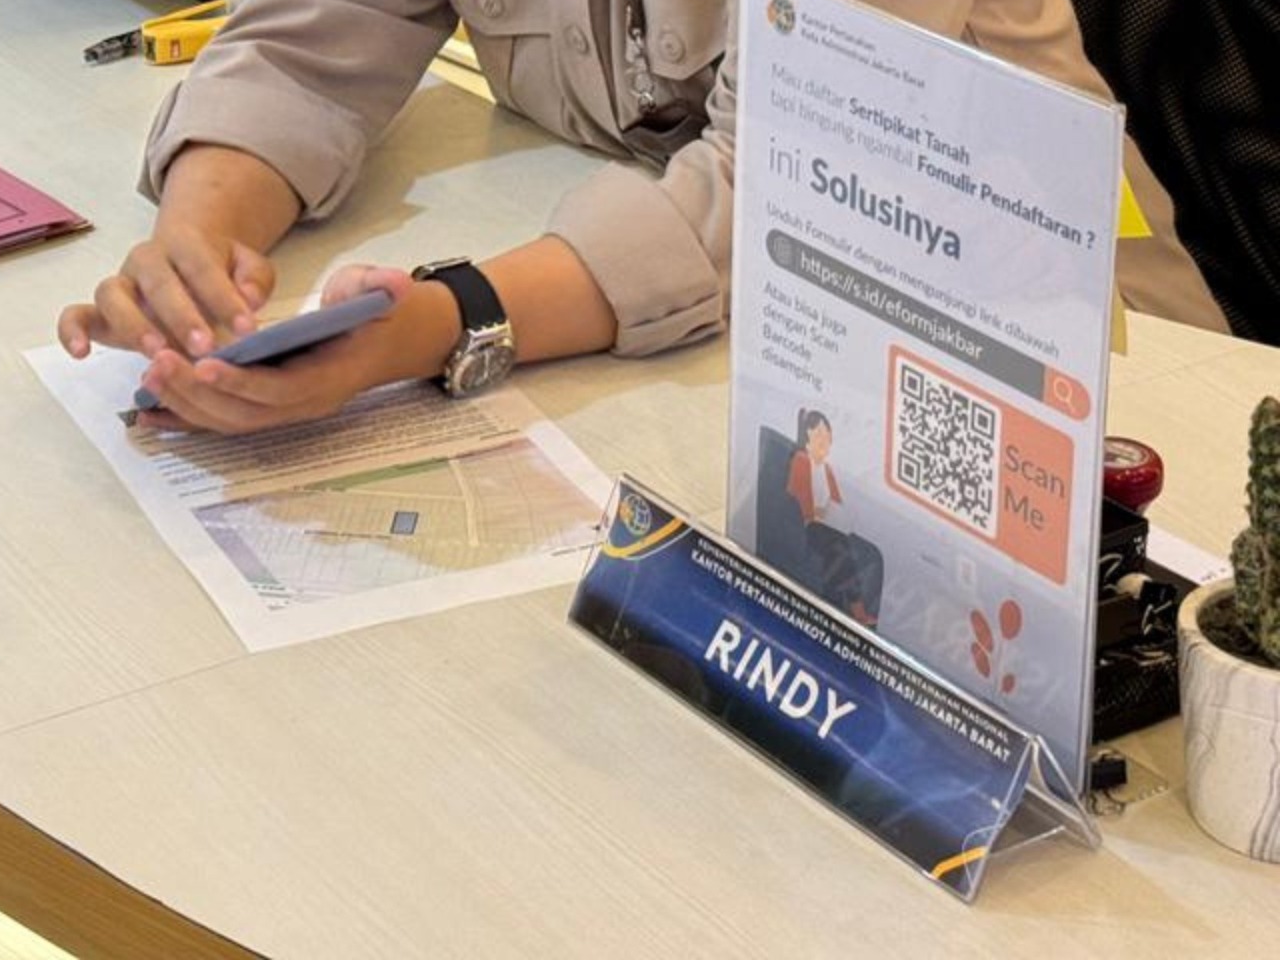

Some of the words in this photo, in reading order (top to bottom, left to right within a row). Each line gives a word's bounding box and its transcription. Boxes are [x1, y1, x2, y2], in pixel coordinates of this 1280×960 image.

[771, 63, 802, 91] Mau
[805, 79, 847, 110] daftar
[848, 96, 922, 146] Sertipikat
[924, 128, 971, 167] Tanah
[902, 71, 926, 89] Barat
[769, 136, 803, 183] ini
[809, 156, 962, 261] Solusinya
[917, 154, 978, 198] Fomulir
[980, 182, 1084, 246] Pendaftaran
[1086, 230, 1097, 250] ?
[763, 280, 793, 308] Atau
[767, 200, 804, 232] Unduh
[853, 246, 898, 279] dengan
[979, 306, 1003, 329] link
[1004, 320, 1062, 361] dibawah
[800, 249, 986, 362] https://s.id/eformjakbar
[1003, 484, 1046, 532] Me
[1004, 443, 1066, 500] Scan
[690, 549, 734, 586] KANTOR
[832, 640, 915, 703] ADMINISTRASI
[913, 694, 968, 738] JAKARTA
[968, 727, 1012, 763] BARAT
[703, 618, 858, 740] RINDY
